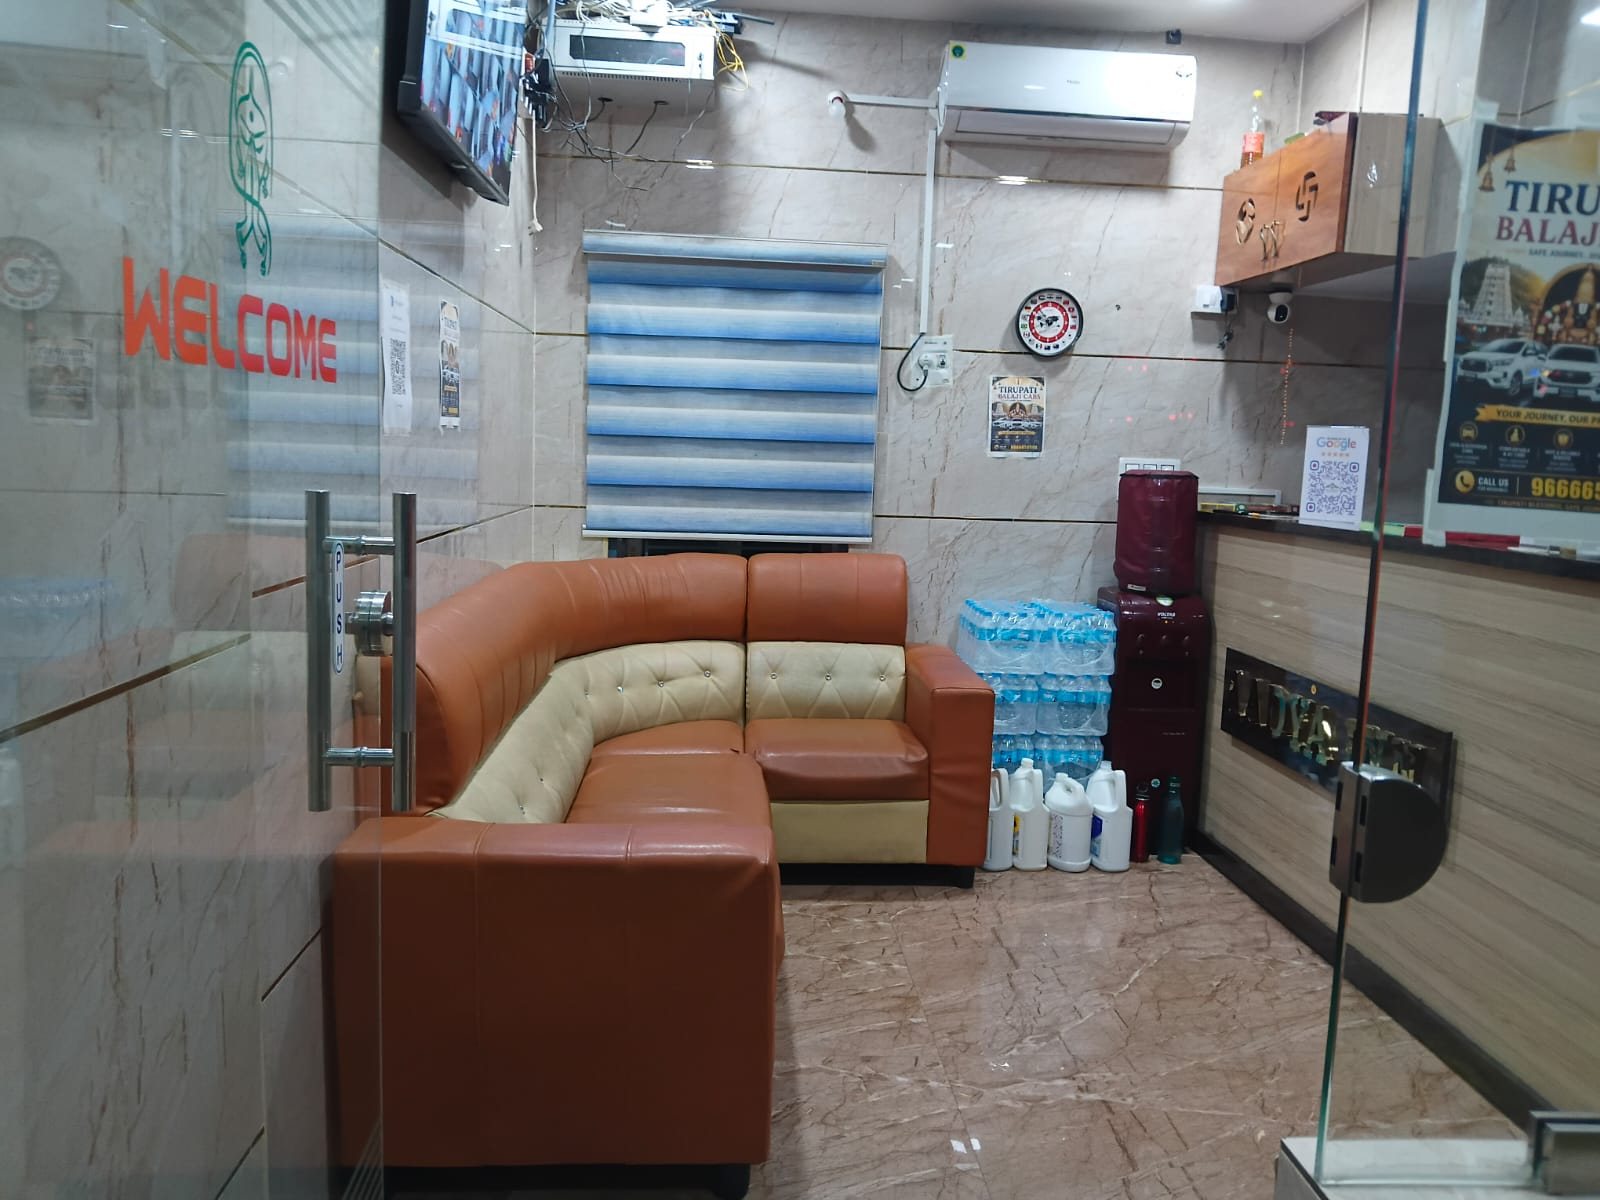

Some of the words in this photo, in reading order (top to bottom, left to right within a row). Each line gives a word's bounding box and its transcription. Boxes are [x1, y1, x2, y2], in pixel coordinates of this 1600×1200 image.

[122, 255, 337, 384] WELCOME
[1496, 407, 1522, 418] YOUR
[1568, 414, 1589, 425] OUR
[1316, 436, 1357, 452] Google
[1478, 476, 1496, 487] CALL
[1498, 478, 1509, 488] US
